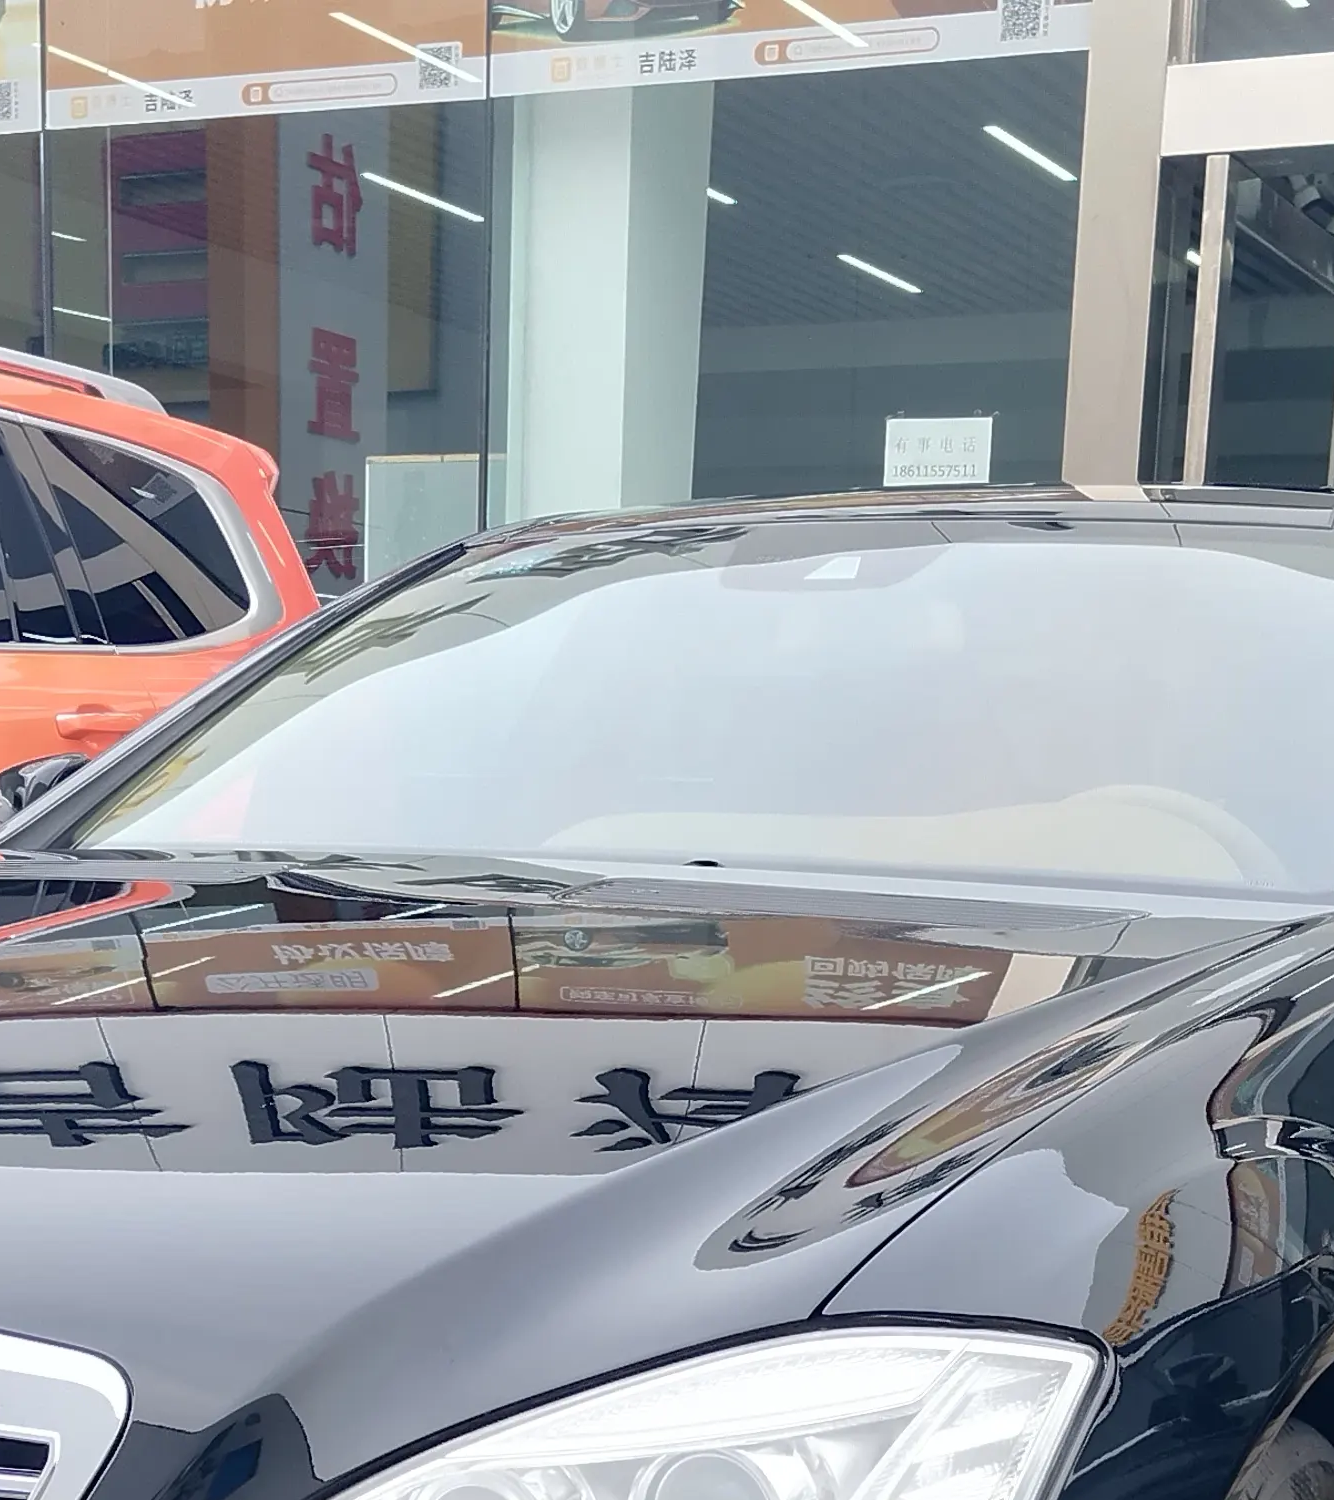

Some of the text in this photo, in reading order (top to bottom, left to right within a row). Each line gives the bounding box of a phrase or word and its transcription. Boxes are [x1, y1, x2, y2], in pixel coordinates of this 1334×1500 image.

[638, 48, 697, 75] 吉陆泽
[895, 437, 978, 454] 有事电话
